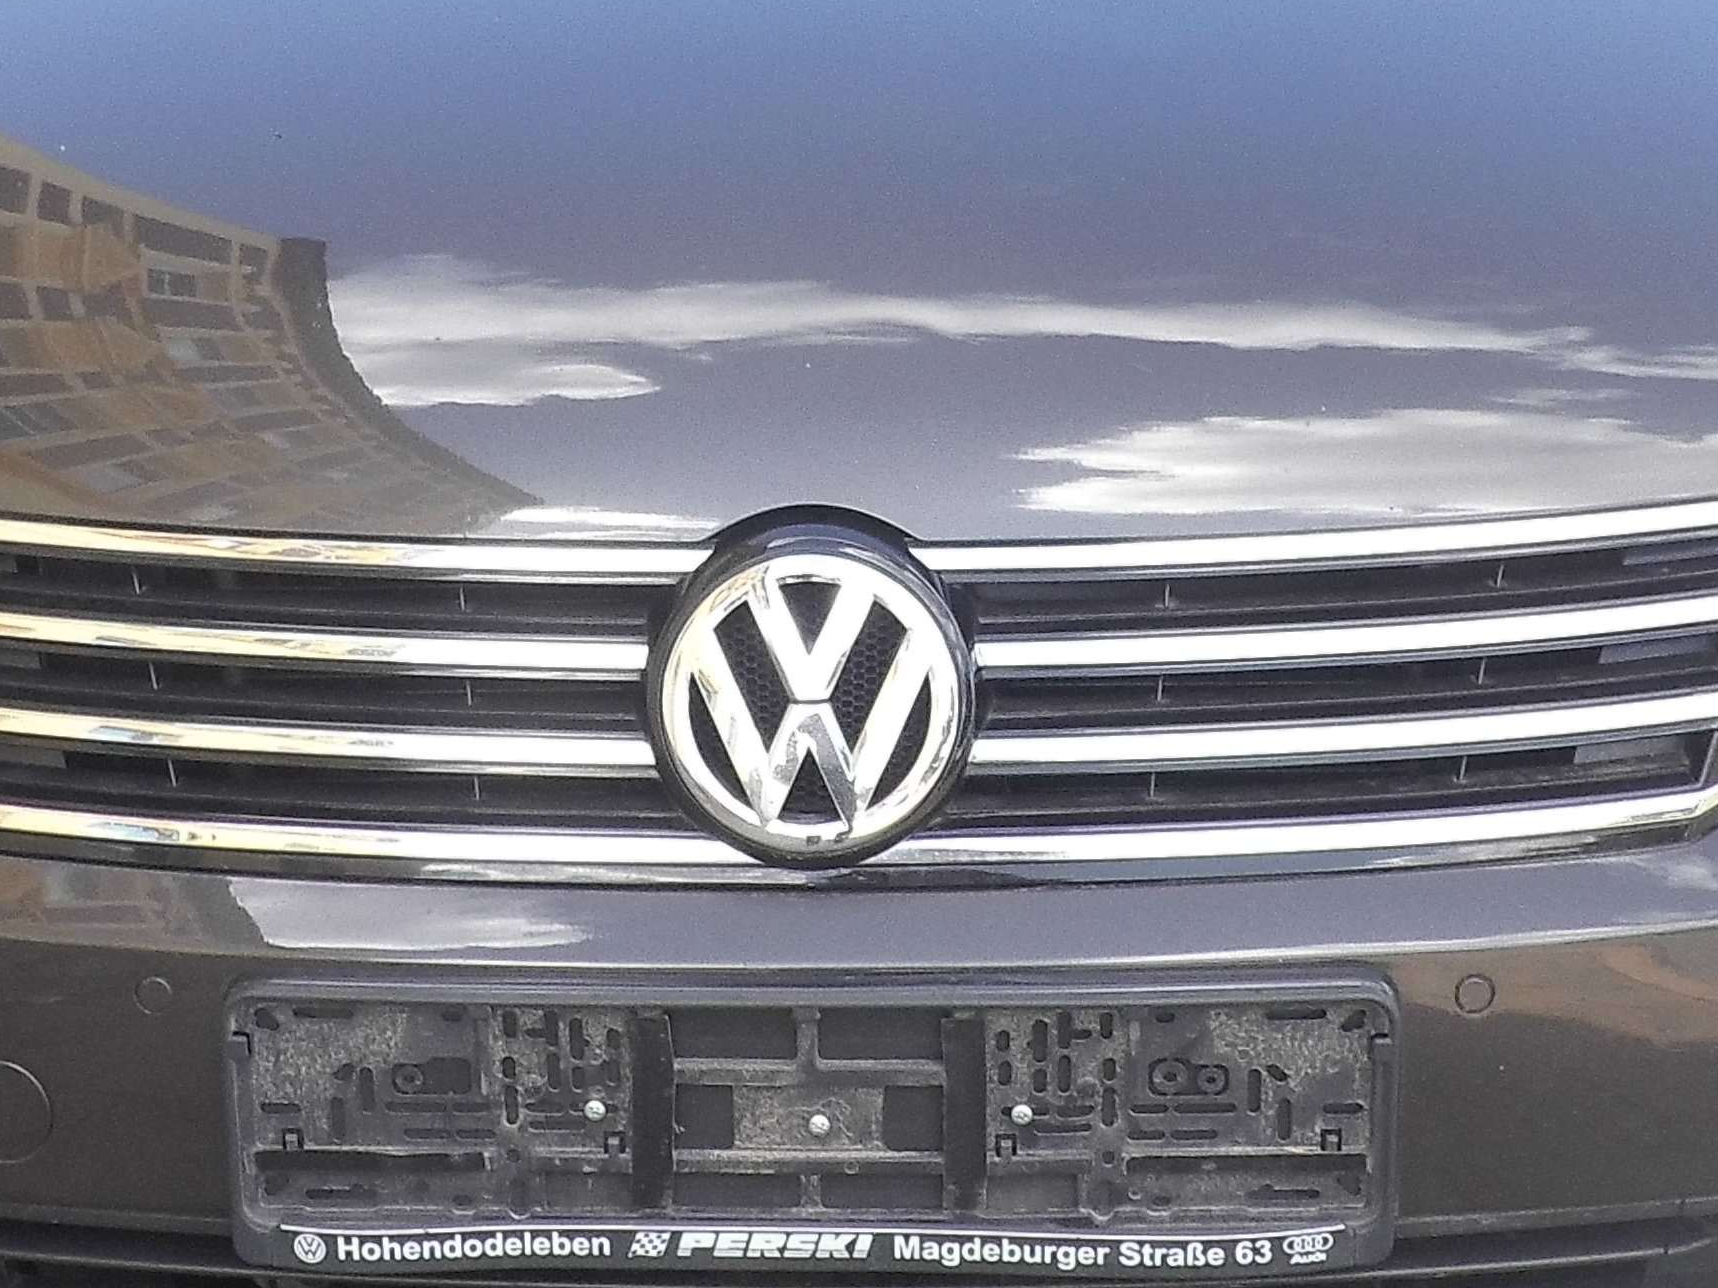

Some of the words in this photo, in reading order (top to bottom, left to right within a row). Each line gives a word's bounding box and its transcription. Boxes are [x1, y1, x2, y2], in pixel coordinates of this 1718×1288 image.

[666, 556, 957, 840] VW
[294, 1233, 327, 1263] VW
[336, 1232, 611, 1261] Hohendodeleben
[676, 1231, 874, 1259] PERSKI
[893, 1235, 1111, 1270] Magdeburger
[1118, 1242, 1226, 1266] Straße
[1234, 1240, 1273, 1265] 63
